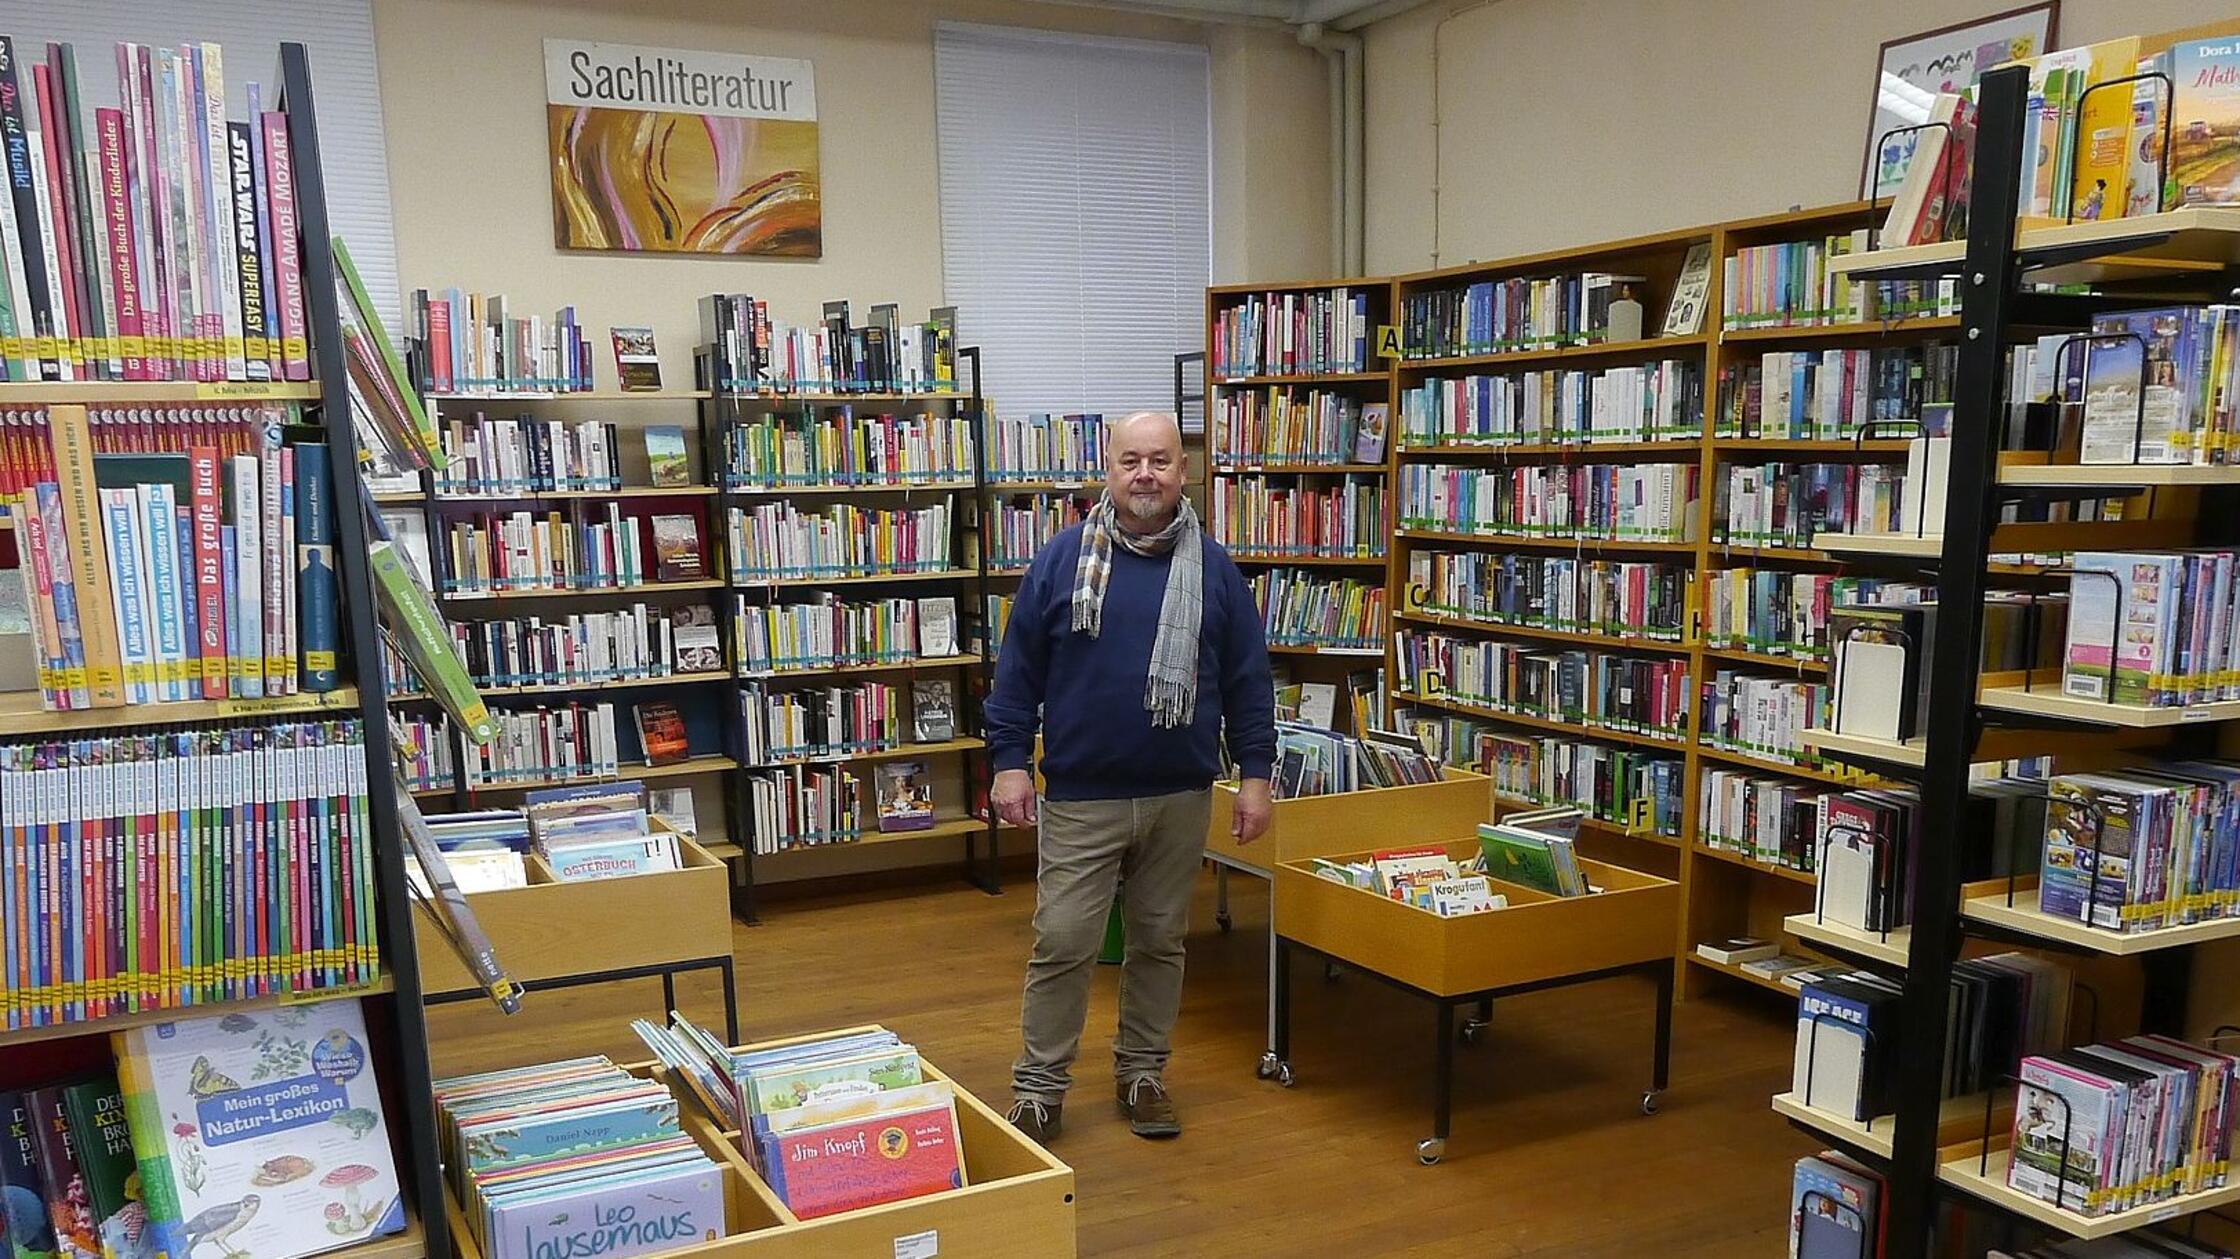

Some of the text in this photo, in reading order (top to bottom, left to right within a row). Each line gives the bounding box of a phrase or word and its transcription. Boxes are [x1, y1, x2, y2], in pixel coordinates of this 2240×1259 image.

[2199, 46, 2232, 58] Dora
[570, 51, 792, 112] Sachliteratur
[0, 82, 17, 111] Das
[10, 136, 31, 189] Musik!
[104, 120, 135, 316] Das große Buch der Kinderlieder
[231, 129, 263, 333] STAR WARS SUPEREASY
[272, 128, 304, 365] LFGANG AMADÉ MOZART
[1382, 328, 1399, 352] A
[198, 459, 213, 497] Buch
[64, 420, 96, 586] ALLES, WAS WIR WISSEN UND WAS NICHT
[310, 501, 318, 515] und
[150, 507, 164, 529] will
[200, 504, 219, 550] große
[154, 530, 168, 573] wissen
[114, 510, 142, 654] Alles was ich wissen will
[157, 574, 170, 594] ich
[202, 558, 217, 584] Das
[161, 595, 173, 620] was
[1410, 584, 1424, 606] C
[162, 622, 176, 651] Alles
[1426, 671, 1440, 694] D
[1636, 801, 1648, 827] F
[563, 860, 636, 877] OSTERBUCH
[1803, 997, 1861, 1024] ICE AGE
[224, 1083, 320, 1112] Mein großes
[206, 1097, 345, 1138] Natur-Lexikon
[546, 1126, 611, 1144] Daniel Napp
[792, 1132, 866, 1162] Jim Knopf
[594, 1203, 636, 1227] Leo
